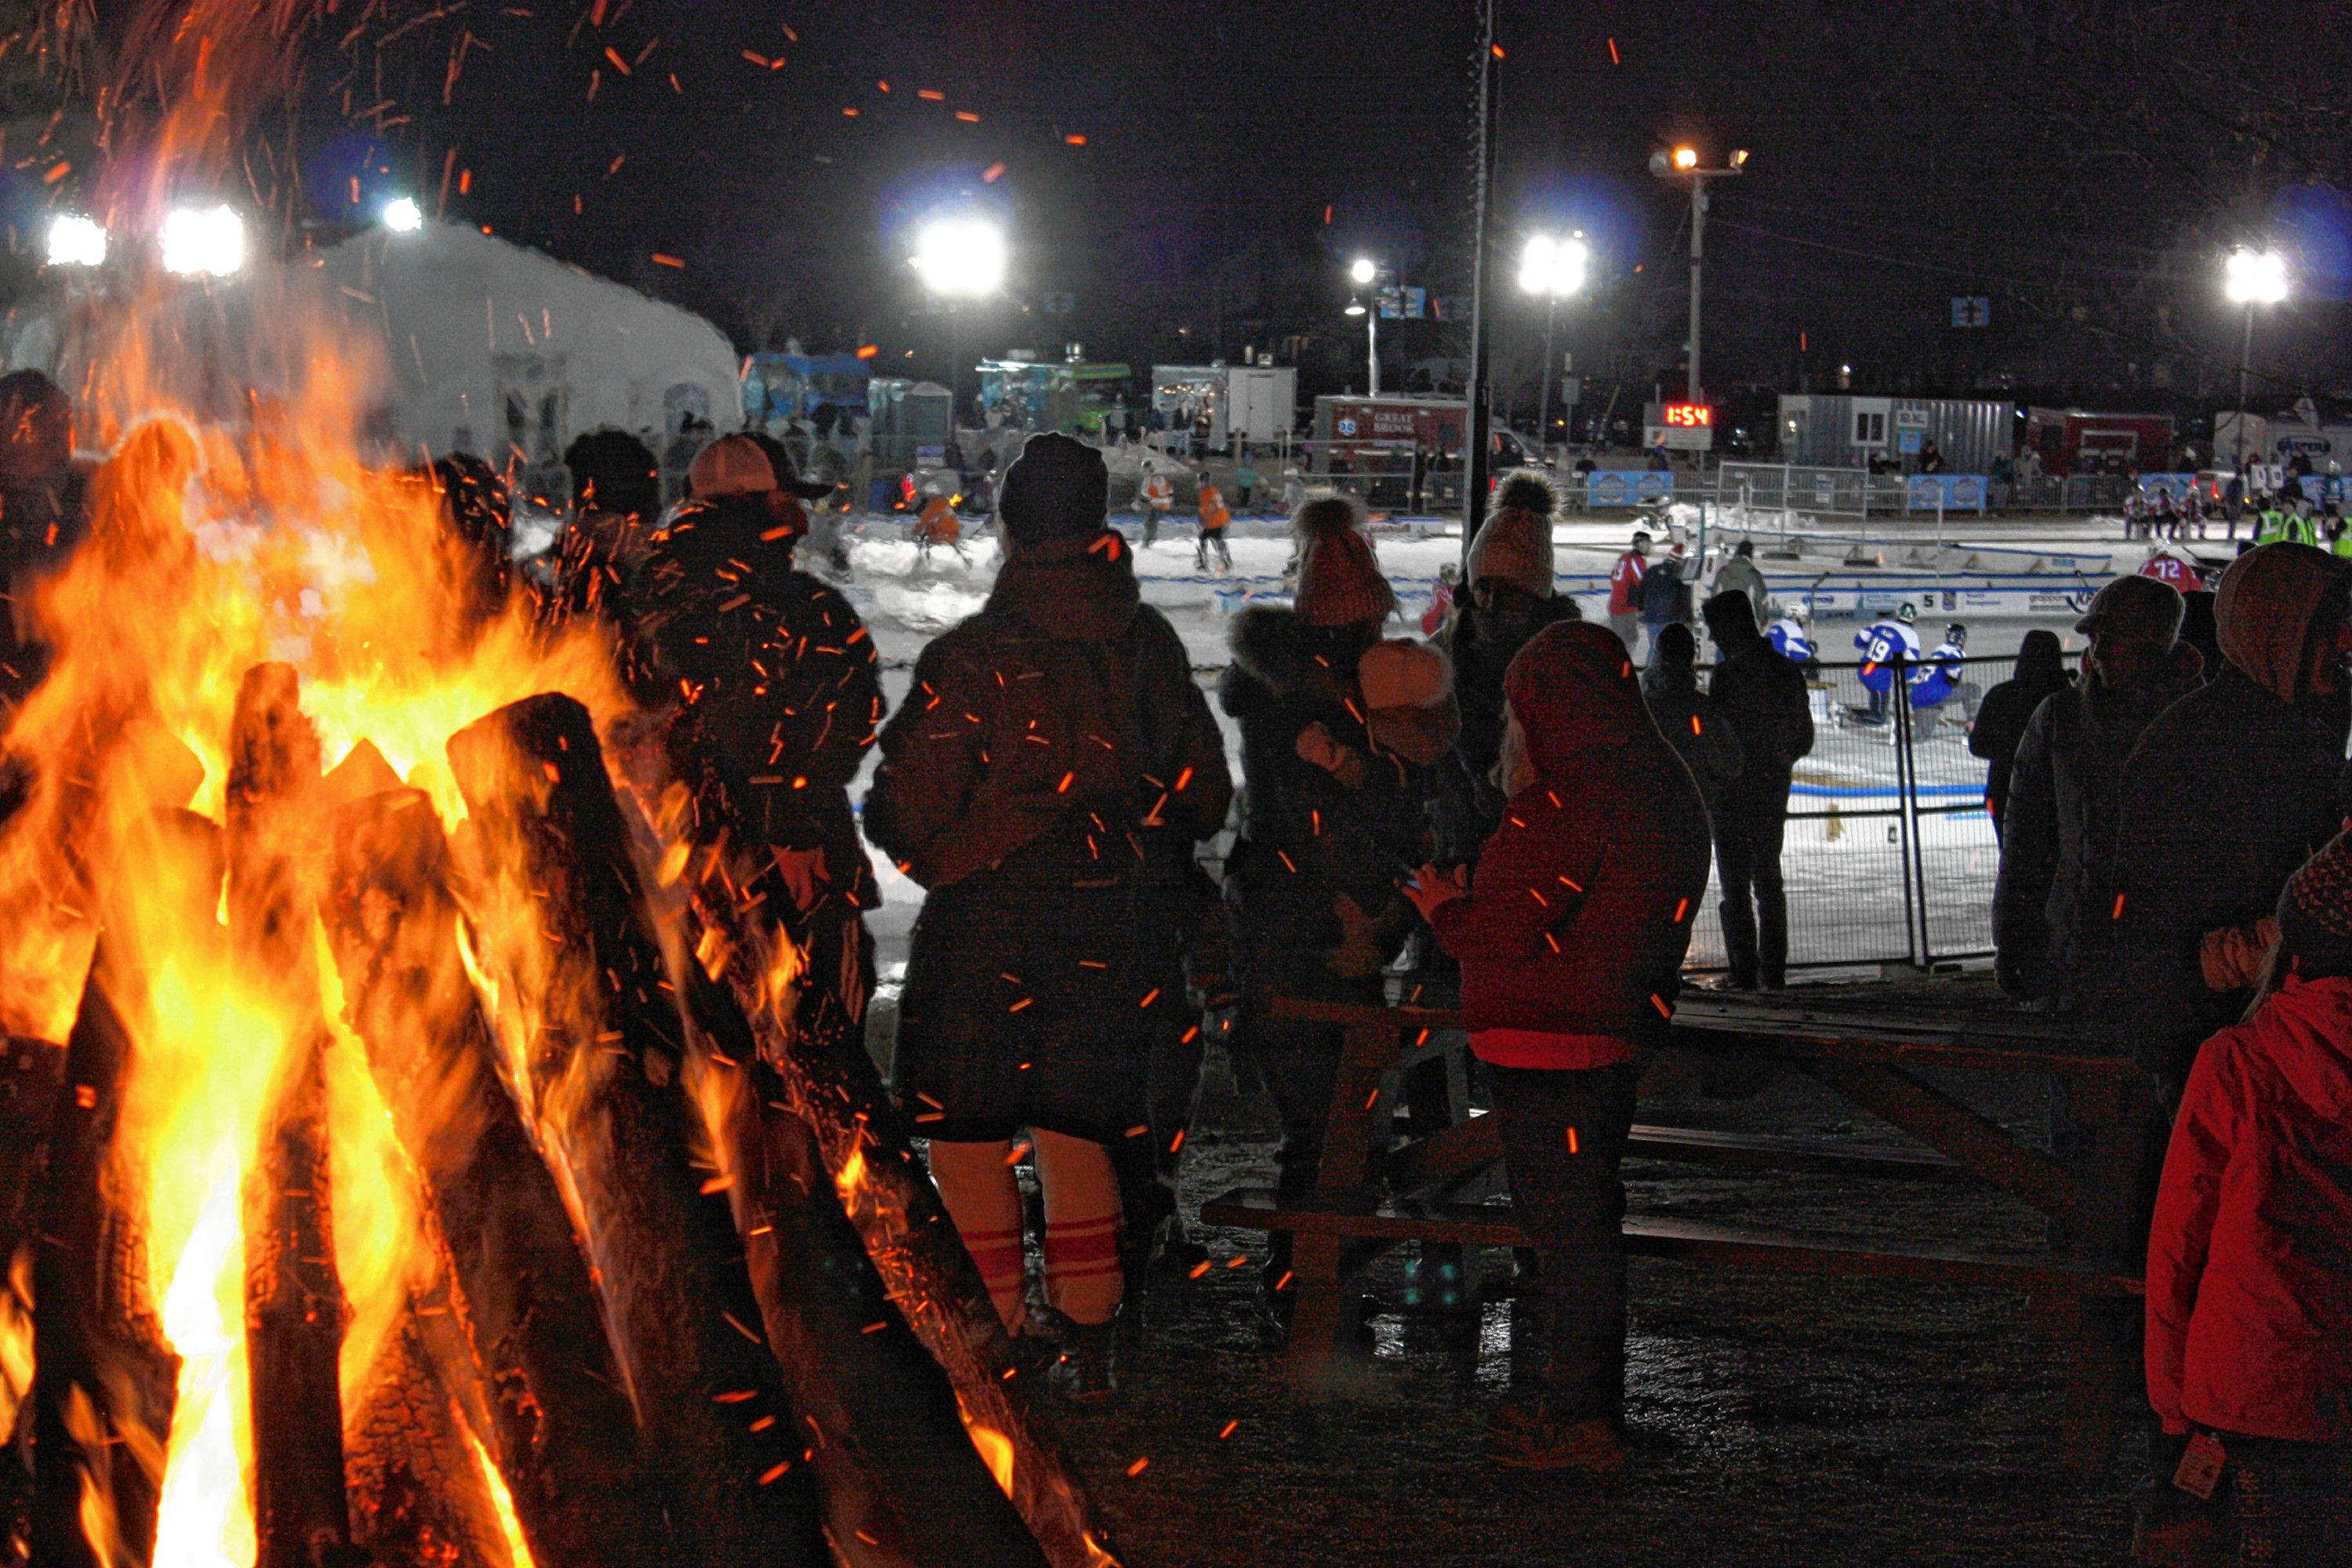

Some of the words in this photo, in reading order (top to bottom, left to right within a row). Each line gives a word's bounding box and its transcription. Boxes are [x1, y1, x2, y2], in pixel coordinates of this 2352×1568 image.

[1668, 406, 1708, 426] 1:54
[2154, 560, 2180, 579] 72
[1923, 594, 1934, 608] 5
[1867, 637, 1890, 662] 19
